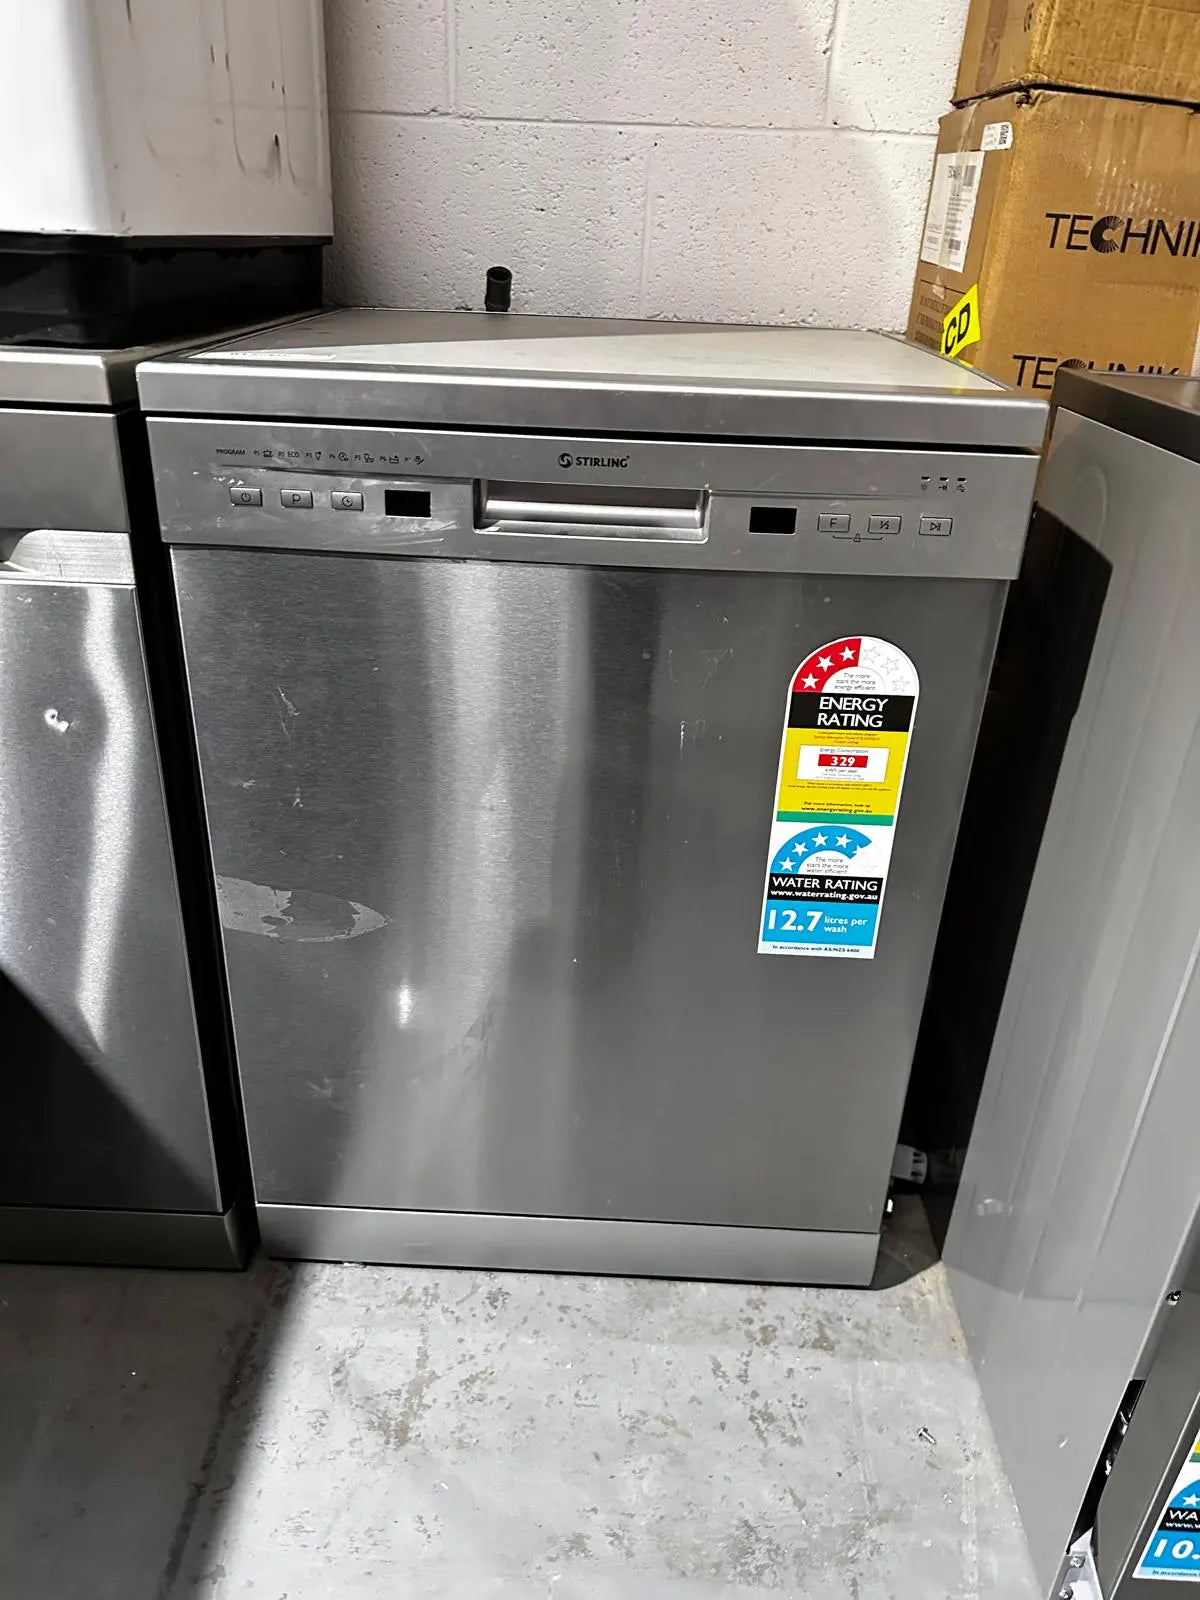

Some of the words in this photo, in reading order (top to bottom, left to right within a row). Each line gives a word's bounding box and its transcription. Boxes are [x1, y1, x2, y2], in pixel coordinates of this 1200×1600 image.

[944, 302, 971, 355] CD
[215, 448, 245, 456] PROGRAM
[575, 456, 628, 468] STIRLING
[292, 493, 301, 505] P
[829, 517, 838, 529] F
[819, 696, 889, 712] ENERGY
[817, 712, 883, 728] RATING
[830, 756, 856, 767] 329
[801, 806, 872, 814] www.energyrating.gov.au
[772, 876, 820, 889] WATER
[824, 879, 878, 891] RATING
[770, 889, 878, 901] www.waterrating.gov.au
[767, 908, 824, 932] 12.7
[824, 915, 848, 925] litres
[850, 918, 869, 927] per
[823, 925, 848, 934] wash
